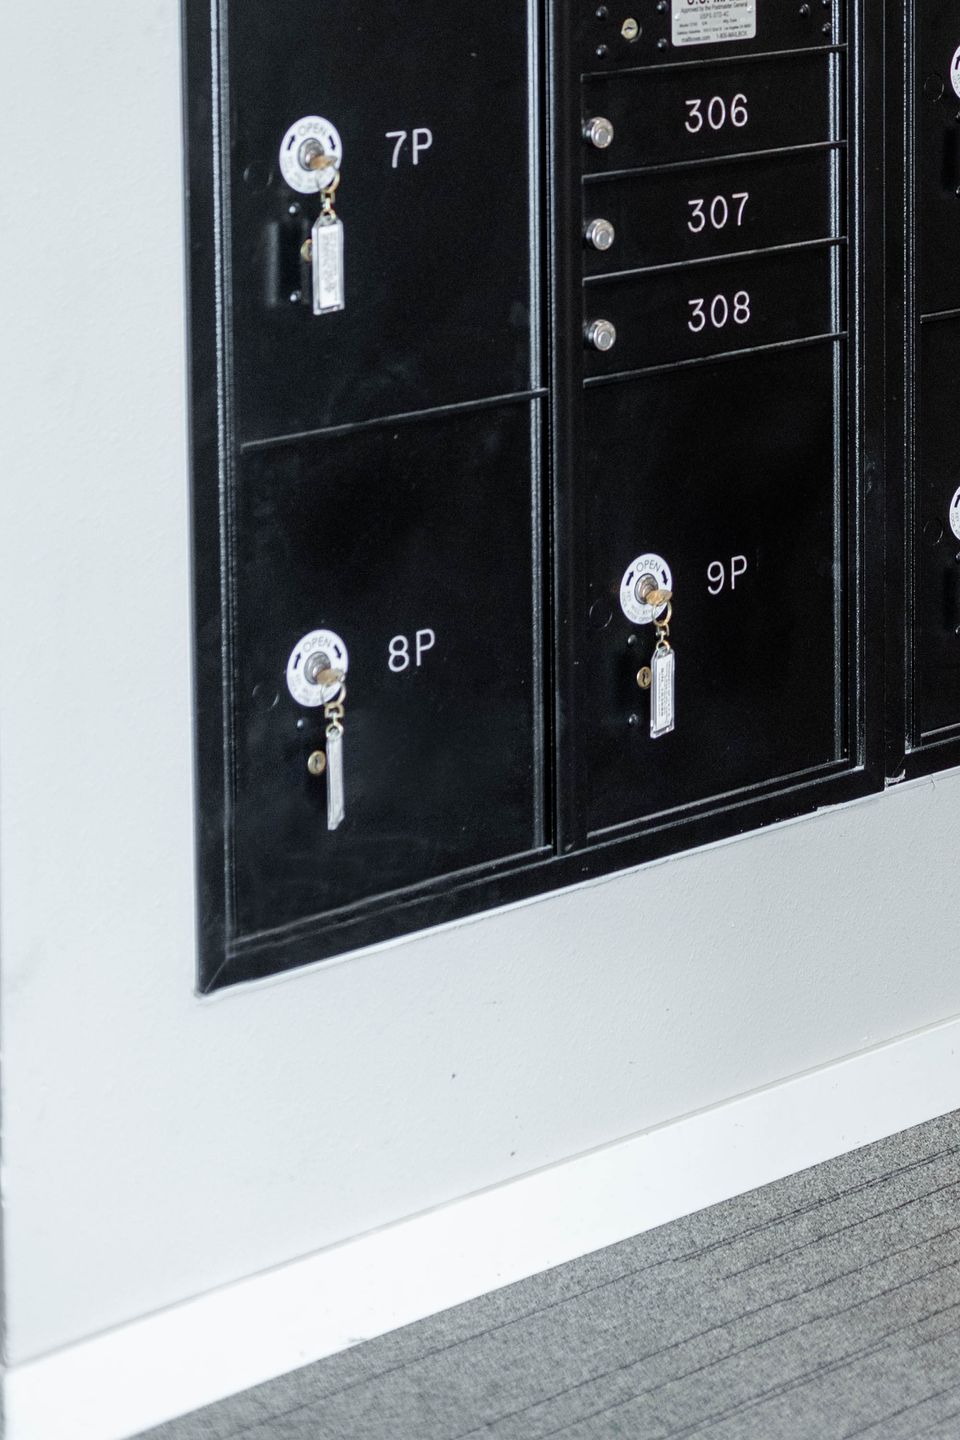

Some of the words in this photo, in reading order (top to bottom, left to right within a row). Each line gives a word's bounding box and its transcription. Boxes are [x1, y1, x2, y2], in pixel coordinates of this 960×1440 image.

[684, 93, 748, 134] 306
[385, 127, 433, 169] 7P
[687, 191, 749, 233] 307
[687, 290, 751, 333] 308
[636, 559, 661, 572] OPEN
[706, 554, 748, 595] 9P
[302, 636, 332, 653] OPEN
[387, 628, 436, 673] 8P
